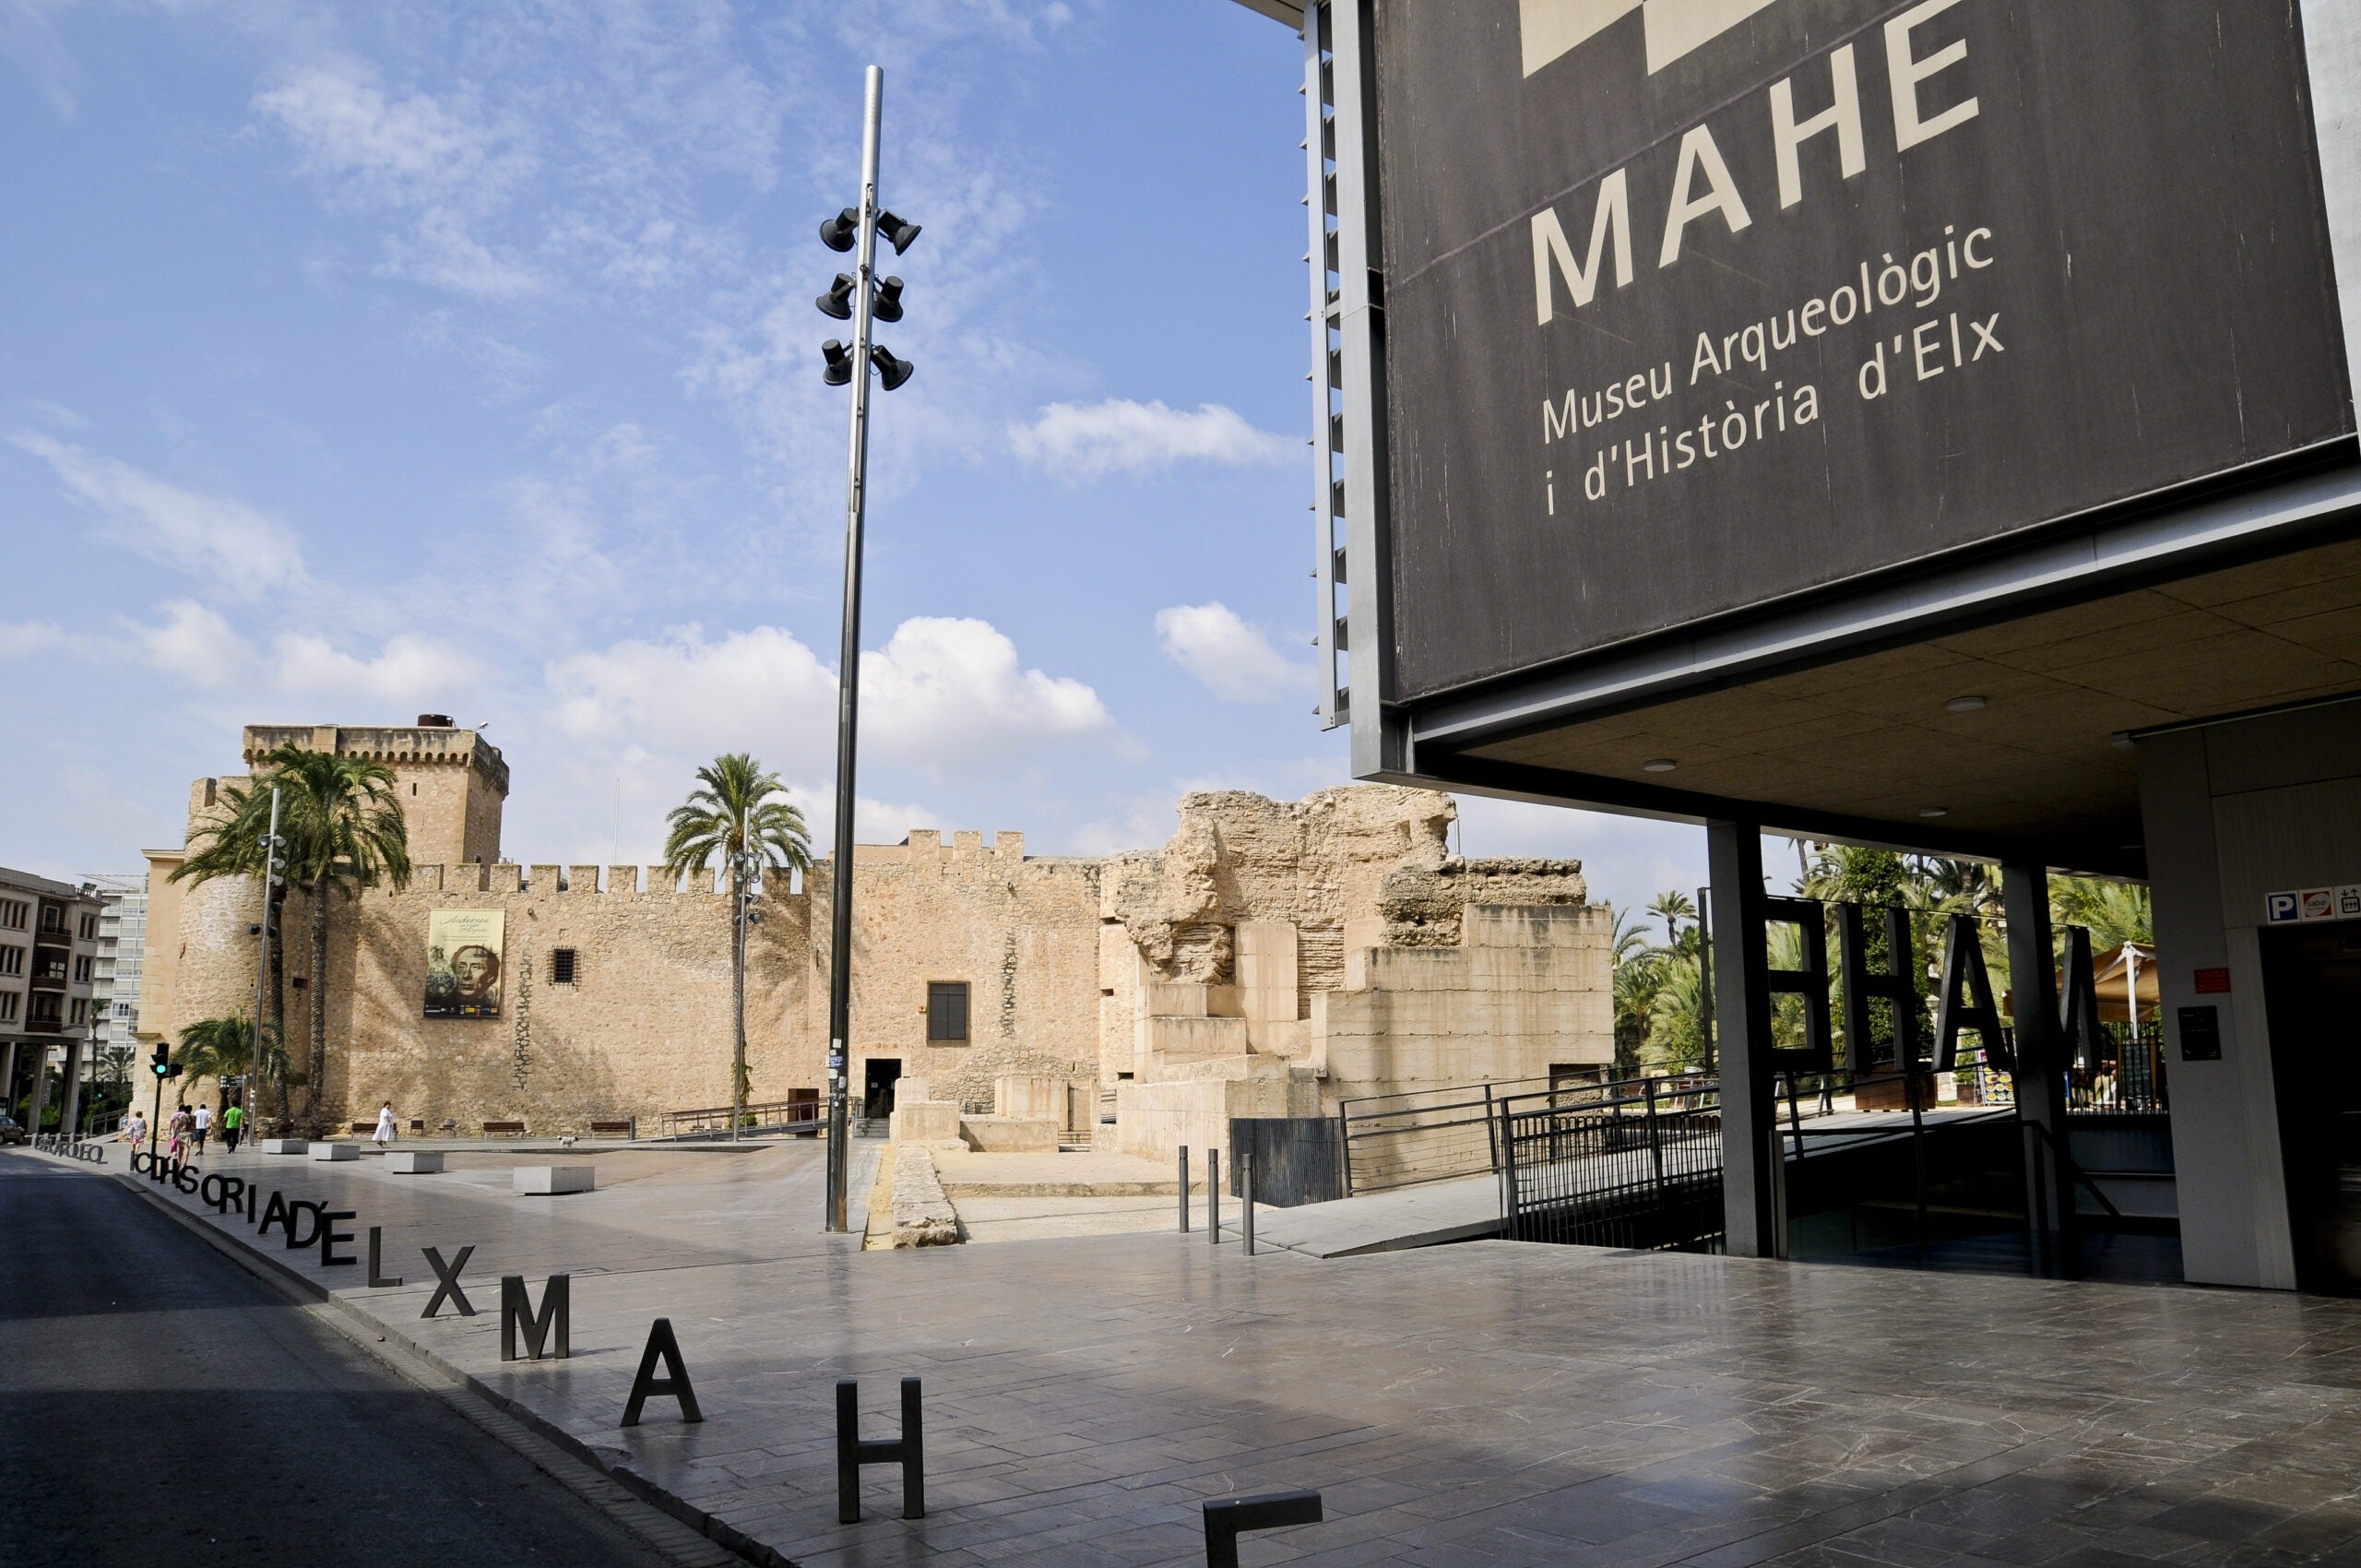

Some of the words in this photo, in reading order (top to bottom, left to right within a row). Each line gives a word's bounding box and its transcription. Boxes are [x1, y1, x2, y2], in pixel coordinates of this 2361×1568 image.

[1531, 0, 1979, 326] MAHE
[1543, 362, 1672, 444] Museu
[1691, 225, 1994, 385] Arqueològic
[1546, 471, 1554, 516] i
[1585, 383, 1819, 500] d'Història
[1859, 313, 2004, 399] d'Elx
[2271, 896, 2295, 920] P
